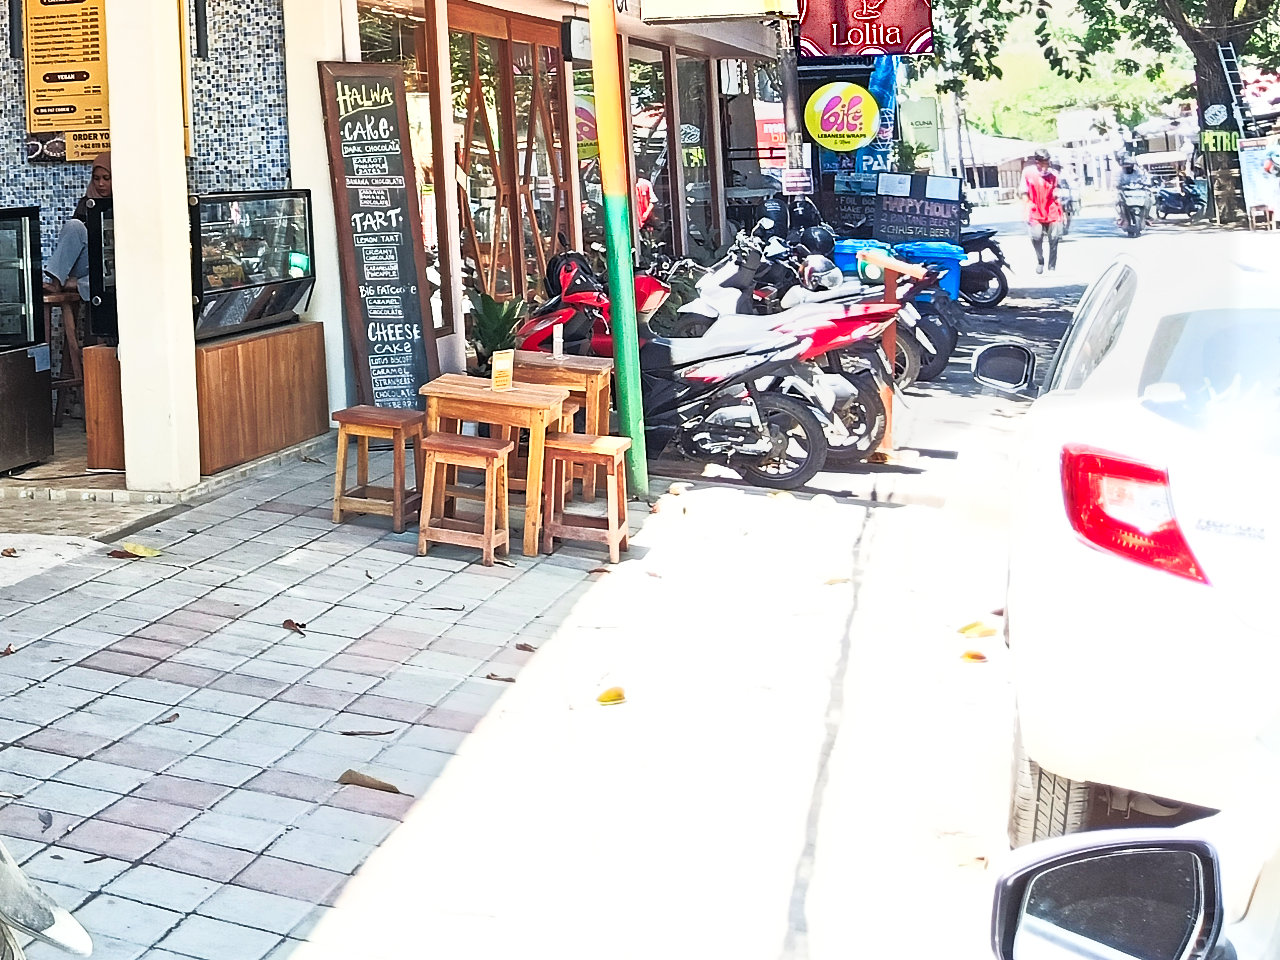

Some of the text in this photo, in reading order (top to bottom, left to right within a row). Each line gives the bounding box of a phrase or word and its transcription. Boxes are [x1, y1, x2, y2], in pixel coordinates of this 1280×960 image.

[831, 22, 901, 46] Lolita
[336, 81, 392, 115] HALWA
[72, 133, 98, 141] ORDER
[1201, 130, 1240, 152] PETRO
[882, 196, 923, 215] HAPPY
[351, 207, 401, 233] TART
[380, 234, 399, 243] TART
[367, 322, 421, 342] CHEESE
